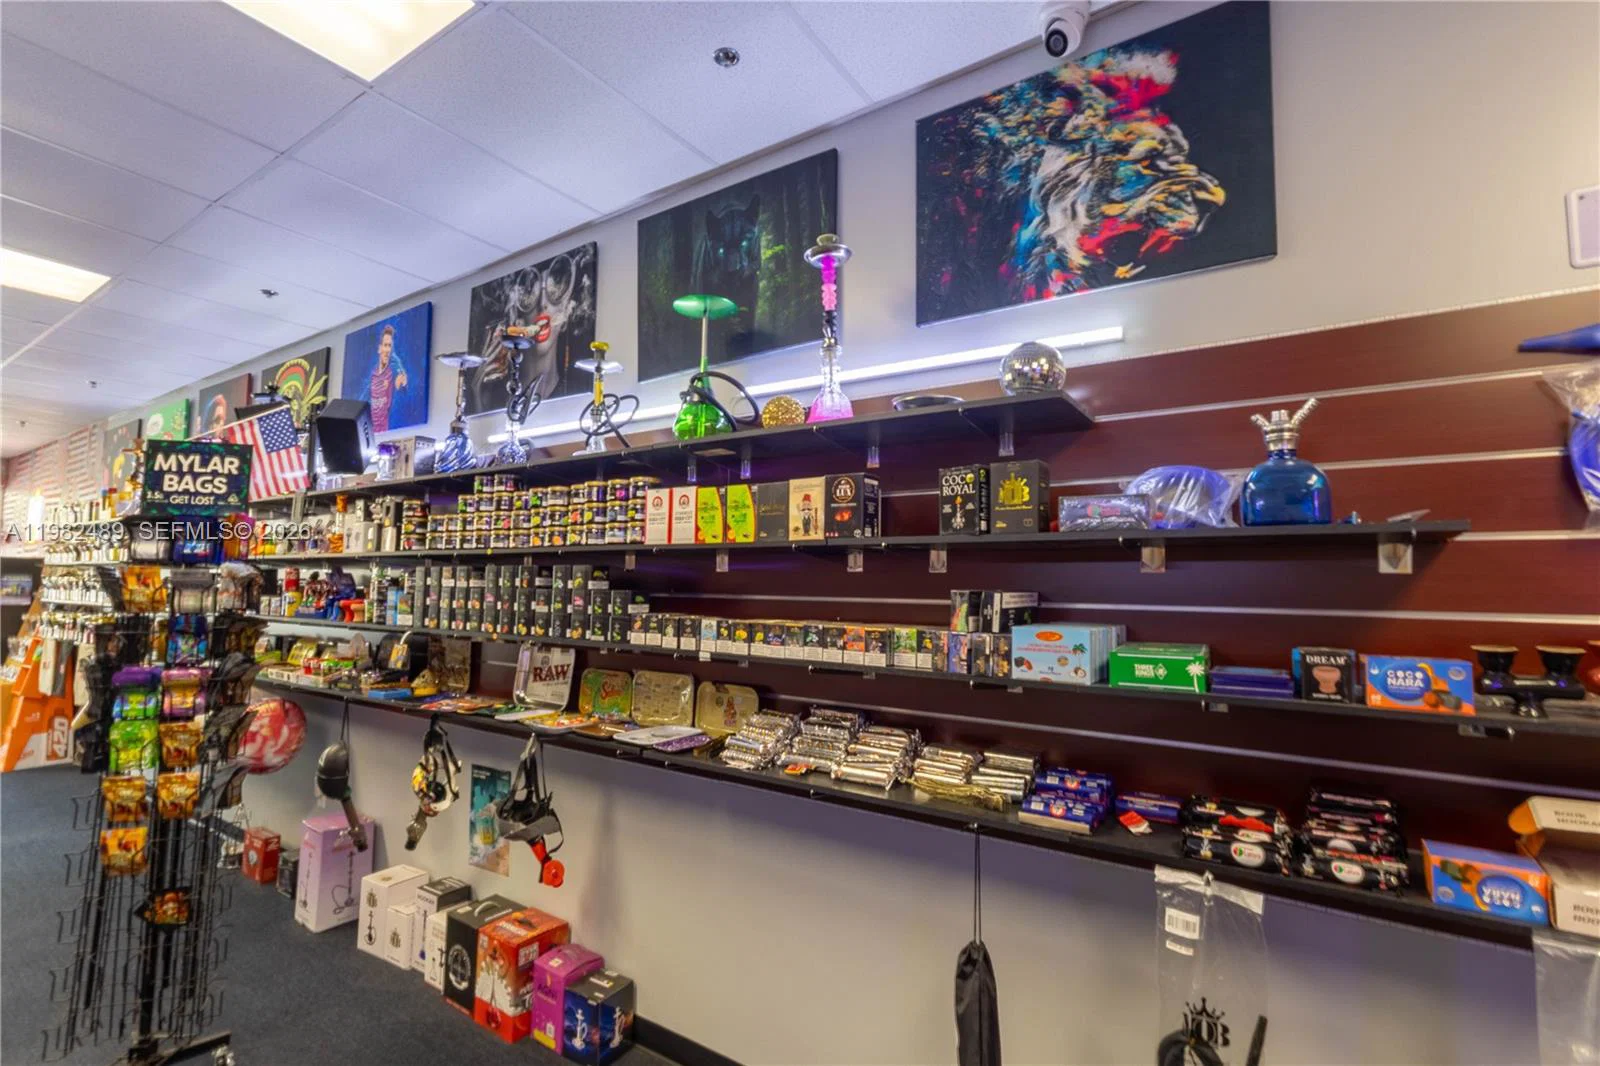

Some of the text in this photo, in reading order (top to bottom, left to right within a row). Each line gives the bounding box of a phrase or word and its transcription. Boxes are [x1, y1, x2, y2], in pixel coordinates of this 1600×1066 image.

[154, 453, 240, 475] MYLAR
[163, 473, 228, 495] BAGS
[942, 484, 976, 497] ROYAL
[170, 495, 215, 506] GET LOST
[1306, 654, 1348, 667] DREAM
[532, 664, 571, 682] RAW
[1386, 669, 1424, 681] COCO
[1386, 679, 1425, 691] NARA
